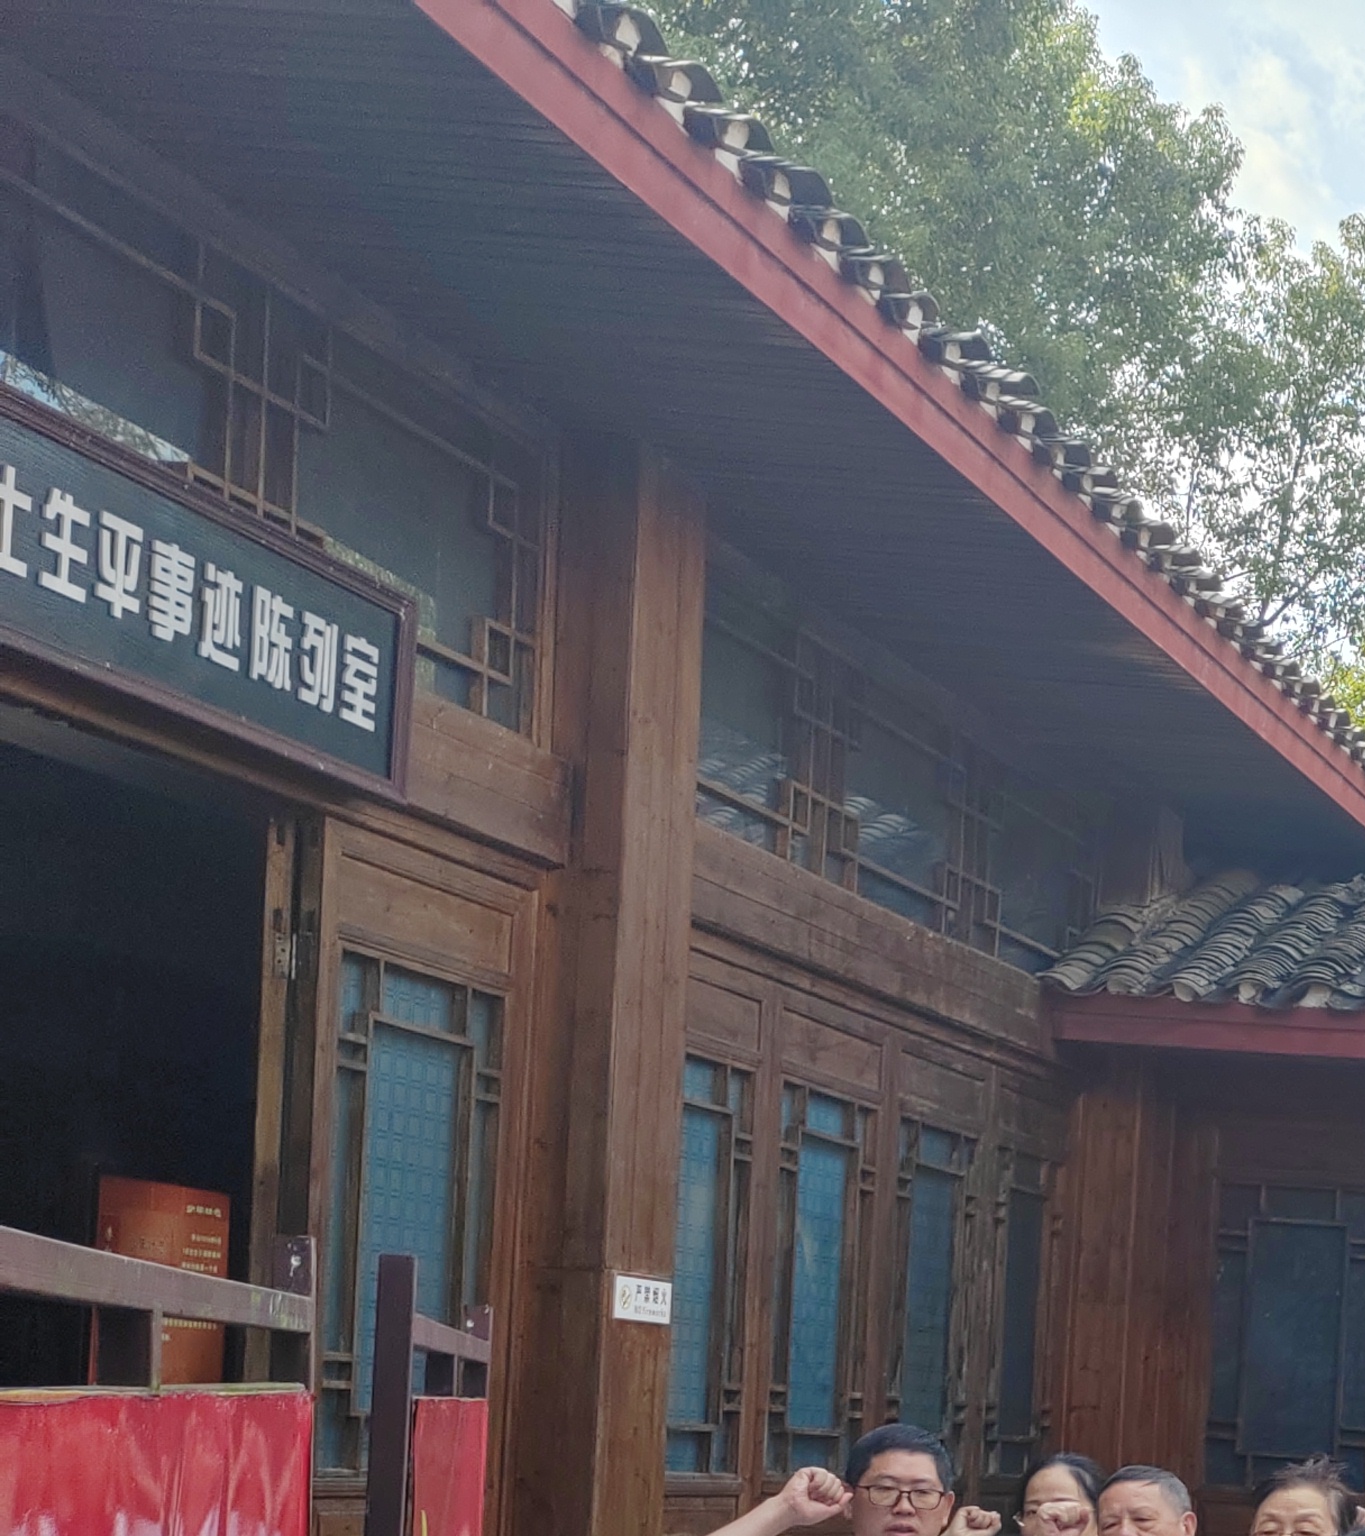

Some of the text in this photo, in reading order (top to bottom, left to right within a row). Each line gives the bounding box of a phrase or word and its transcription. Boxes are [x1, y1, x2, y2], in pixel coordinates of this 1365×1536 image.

[0, 463, 381, 733] 士生平事迹陈列室
